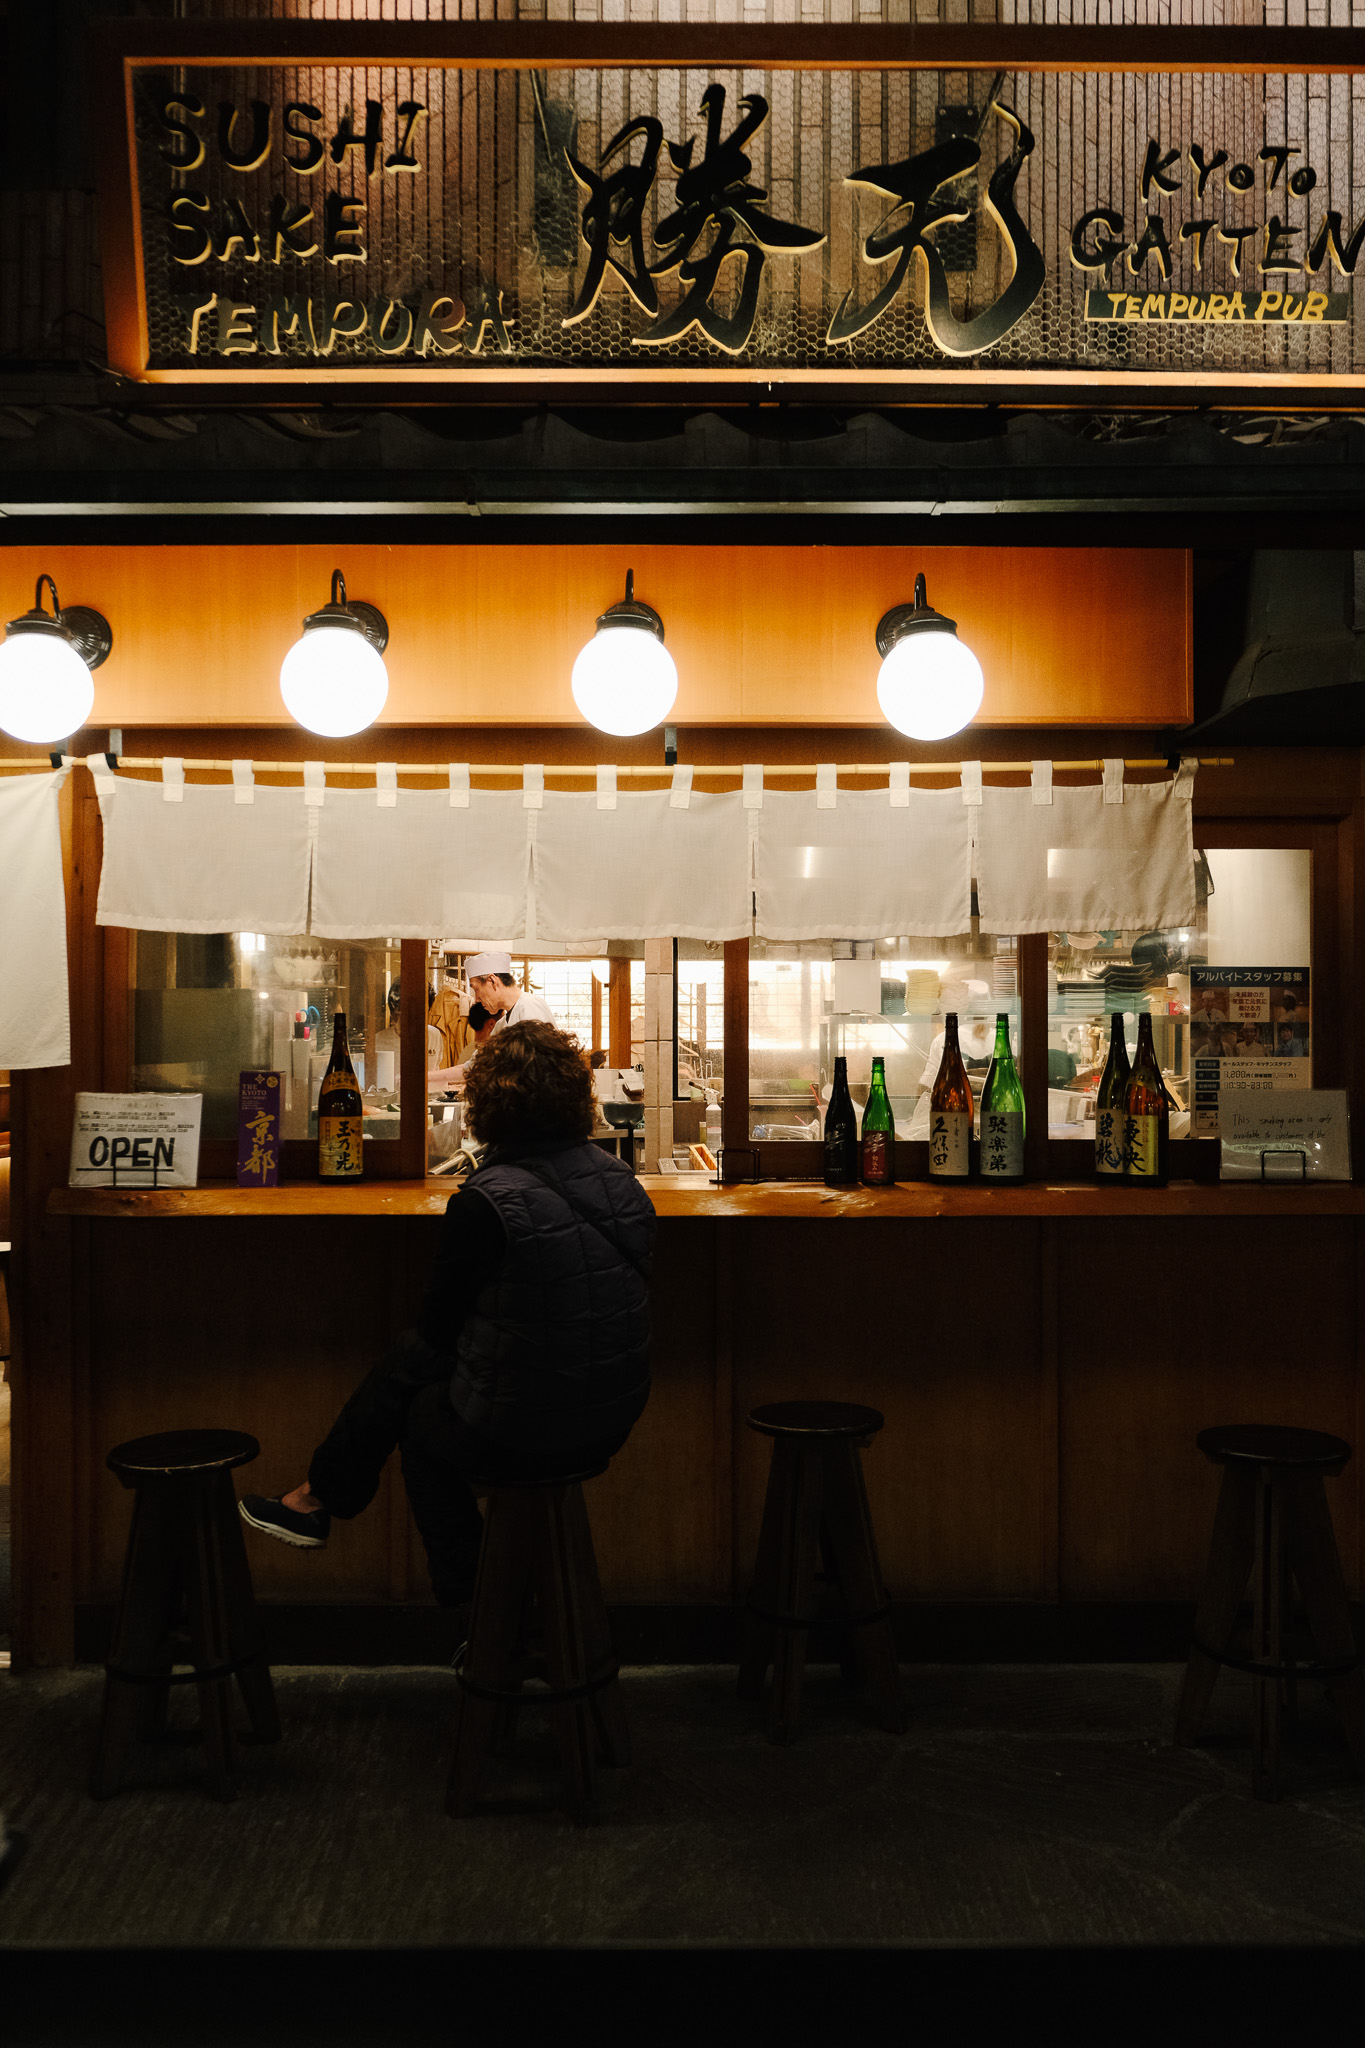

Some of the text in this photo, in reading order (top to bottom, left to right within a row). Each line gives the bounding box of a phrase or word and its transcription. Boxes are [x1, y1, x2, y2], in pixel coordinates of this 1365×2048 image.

[160, 99, 429, 179] SUSHI
[167, 190, 368, 266] SAKE
[1070, 207, 1365, 283] GATTEN
[185, 284, 516, 358] TEMPURA
[1107, 291, 1329, 322] TEMPURA PUB
[1196, 971, 1303, 982] アルバイトスタッフ募集
[336, 1121, 355, 1171] 玉乃光
[930, 1116, 949, 1166] 久保田
[987, 1115, 1009, 1172] 聚楽第
[1123, 1115, 1146, 1172] 豪快
[1232, 1113, 1250, 1127] This
[1259, 1116, 1284, 1128] smoking
[1318, 1114, 1333, 1124] only
[1233, 1130, 1260, 1139] available
[1275, 1131, 1305, 1139] customers
[1307, 1130, 1315, 1139] of
[1316, 1131, 1326, 1139] the
[88, 1135, 176, 1168] OPEN
[241, 1111, 276, 1185] 京都
